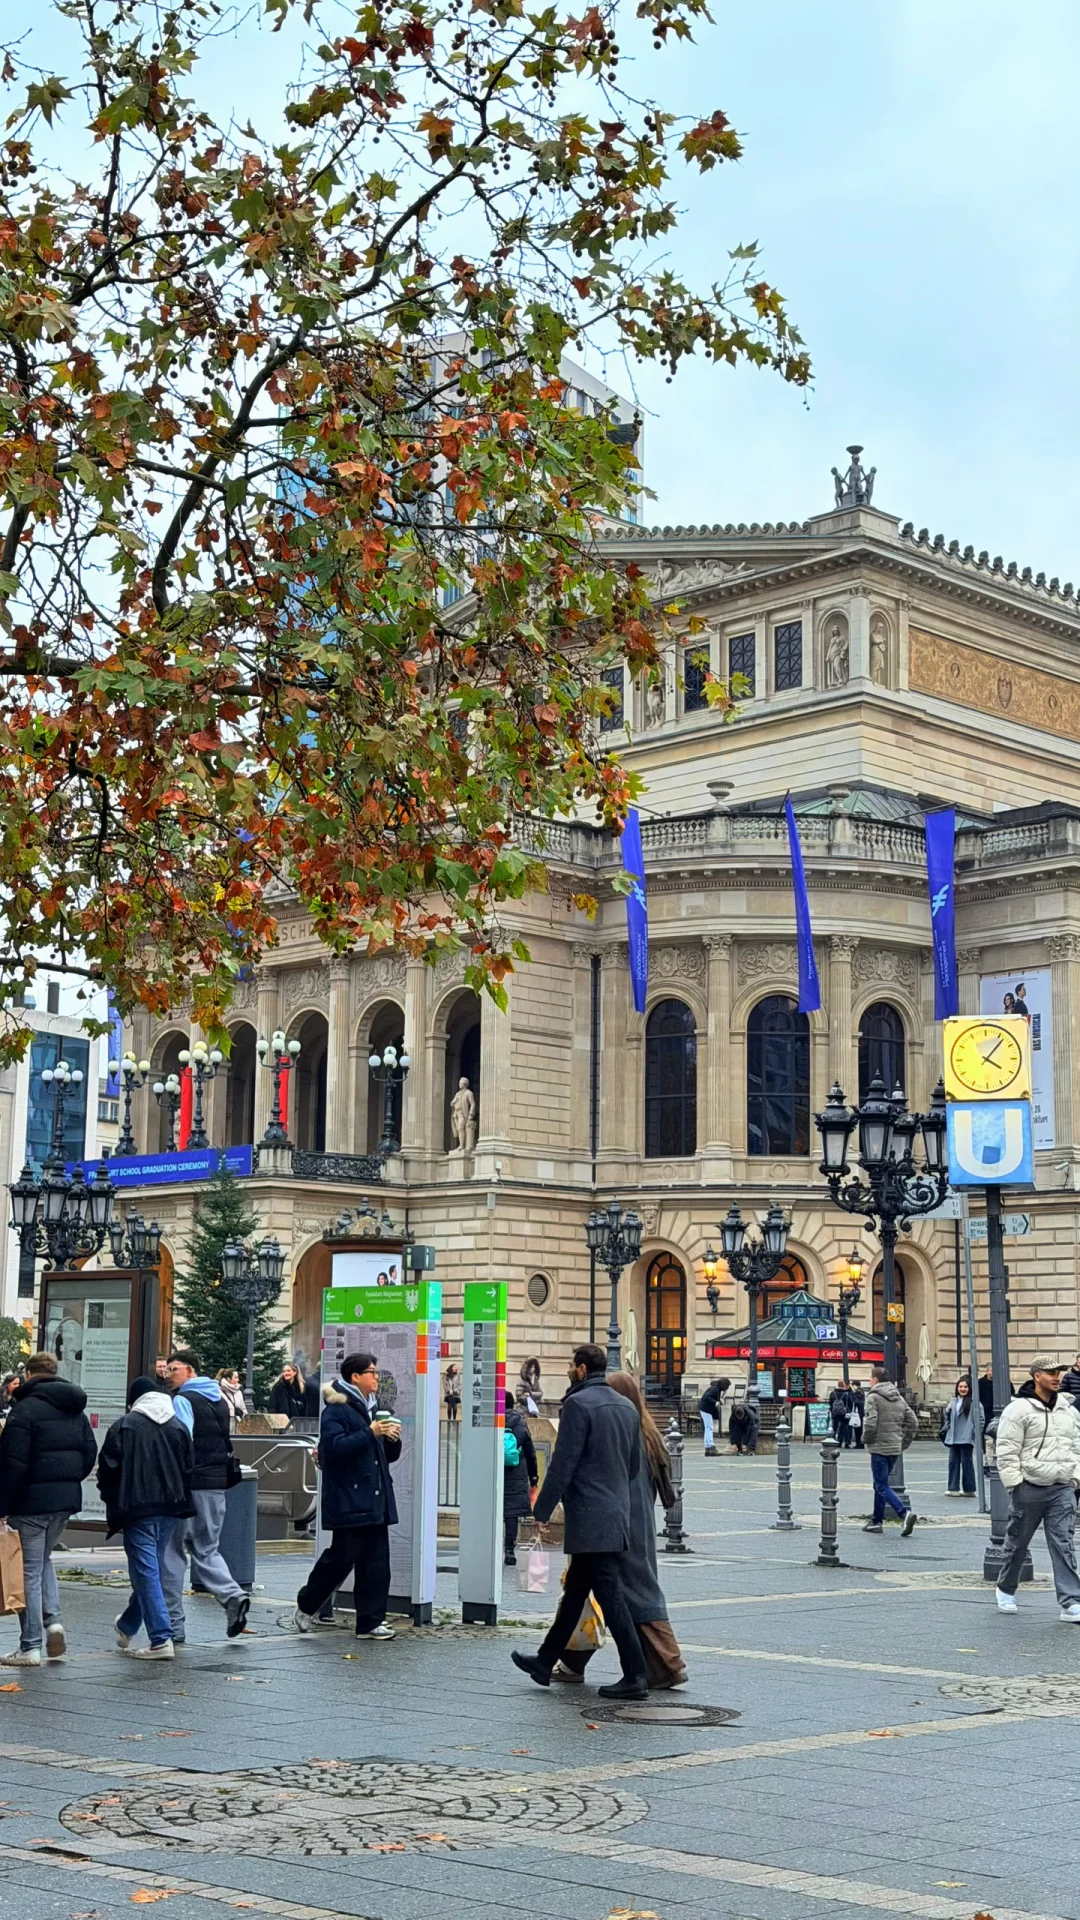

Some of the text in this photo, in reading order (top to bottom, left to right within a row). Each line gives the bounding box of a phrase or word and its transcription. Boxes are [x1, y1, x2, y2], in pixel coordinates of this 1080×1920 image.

[941, 940, 950, 987] Management
[1032, 1013, 1041, 1051] DAS MUSICAL
[1032, 1115, 1048, 1123] nkfurt
[953, 1109, 1025, 1178] U
[88, 1160, 210, 1179] FRAURT SCHOOL GRADUATION CEREMONY
[797, 1308, 804, 1317] P
[818, 1329, 826, 1338] P
